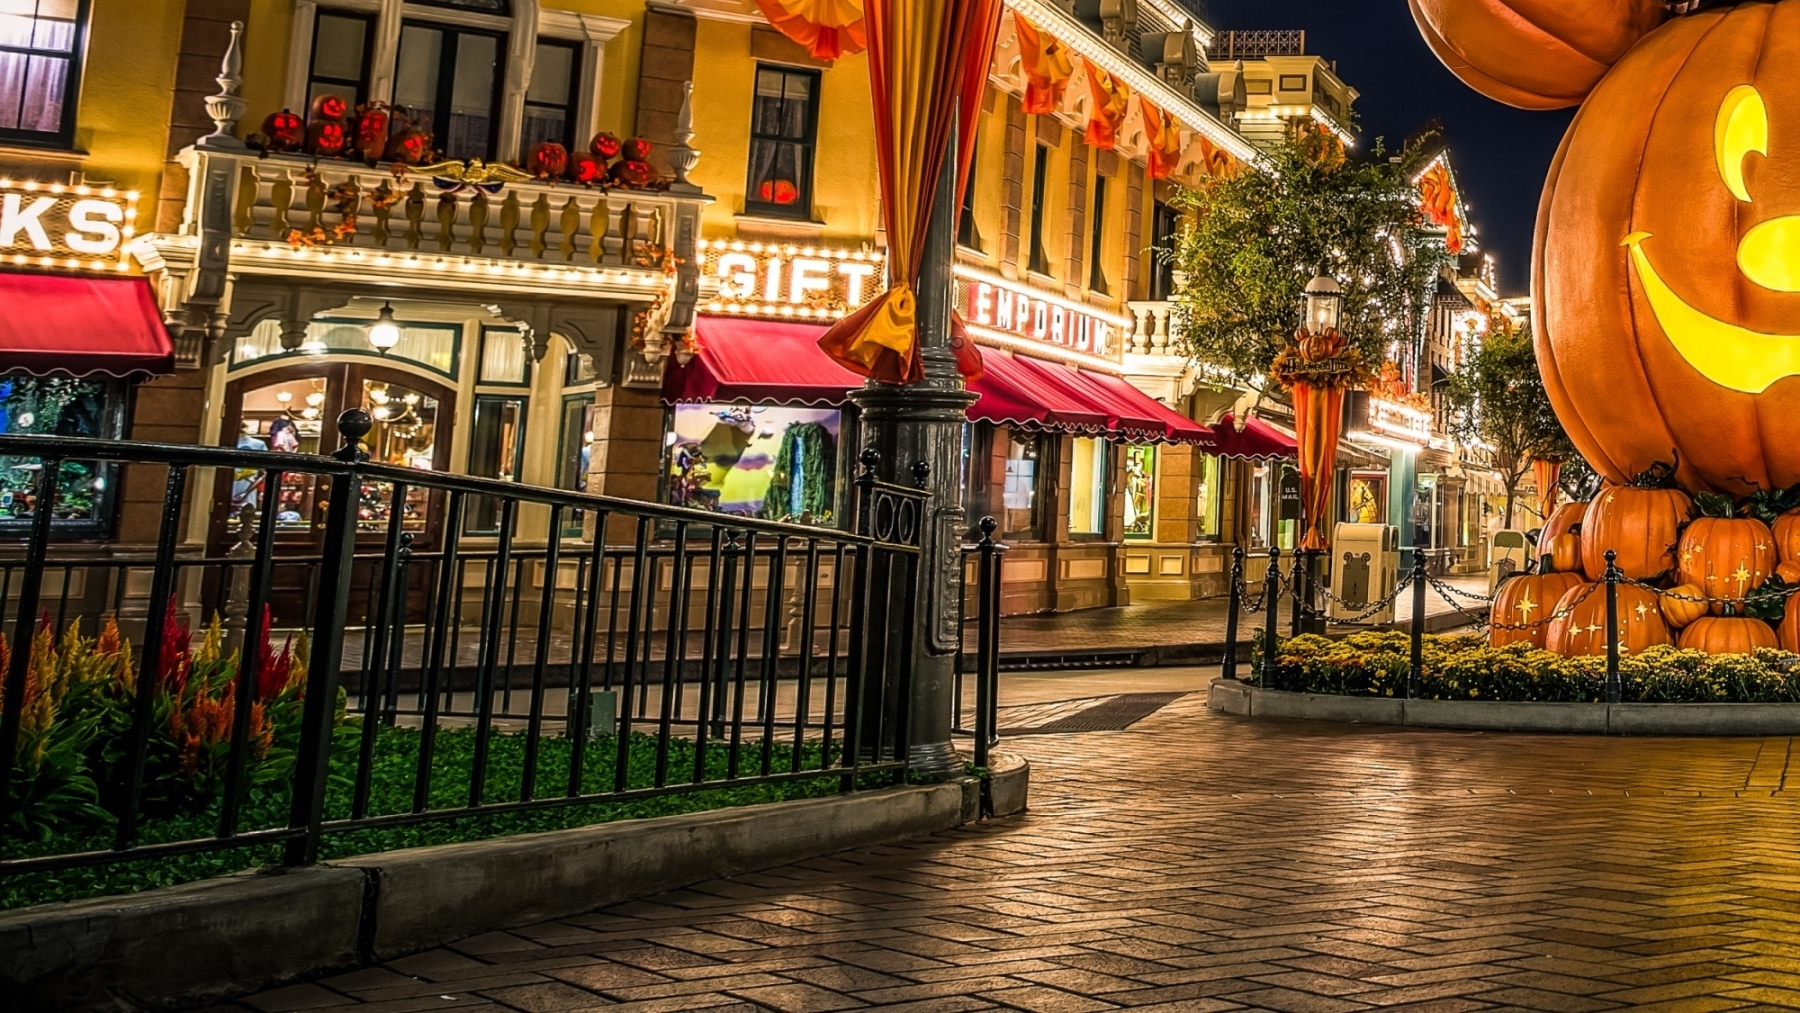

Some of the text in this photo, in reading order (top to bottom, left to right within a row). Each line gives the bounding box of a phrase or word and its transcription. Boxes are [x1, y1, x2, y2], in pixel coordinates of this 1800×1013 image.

[0, 193, 123, 254] KS
[717, 252, 874, 307] GIFT
[977, 281, 1107, 354] EMPORIUM
